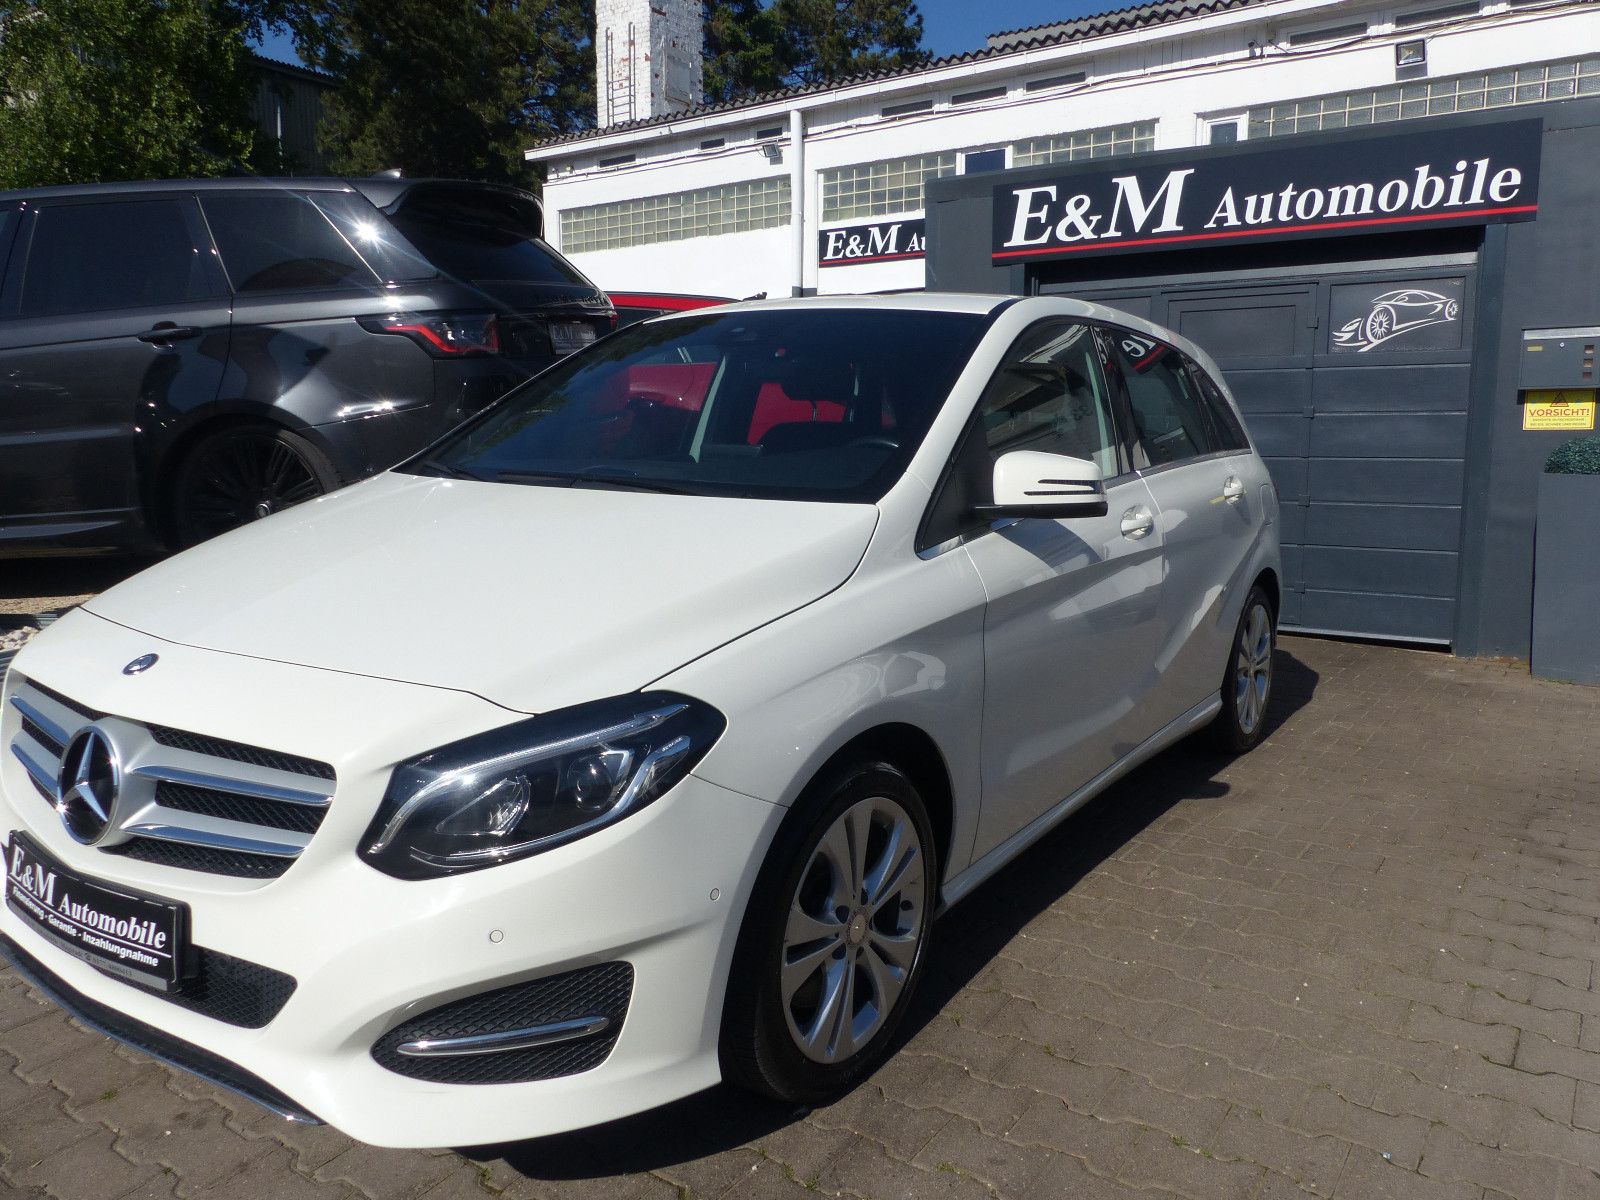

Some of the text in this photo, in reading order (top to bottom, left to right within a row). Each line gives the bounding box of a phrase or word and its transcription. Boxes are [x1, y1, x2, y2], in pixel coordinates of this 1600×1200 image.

[1002, 157, 1523, 248] E&M Automobile
[823, 224, 902, 260] E&M
[1528, 408, 1590, 417] VORSICHT!
[10, 844, 167, 949] E&M Automobile
[48, 914, 77, 937] Garantie
[83, 931, 159, 967] Inzahlungnahme
